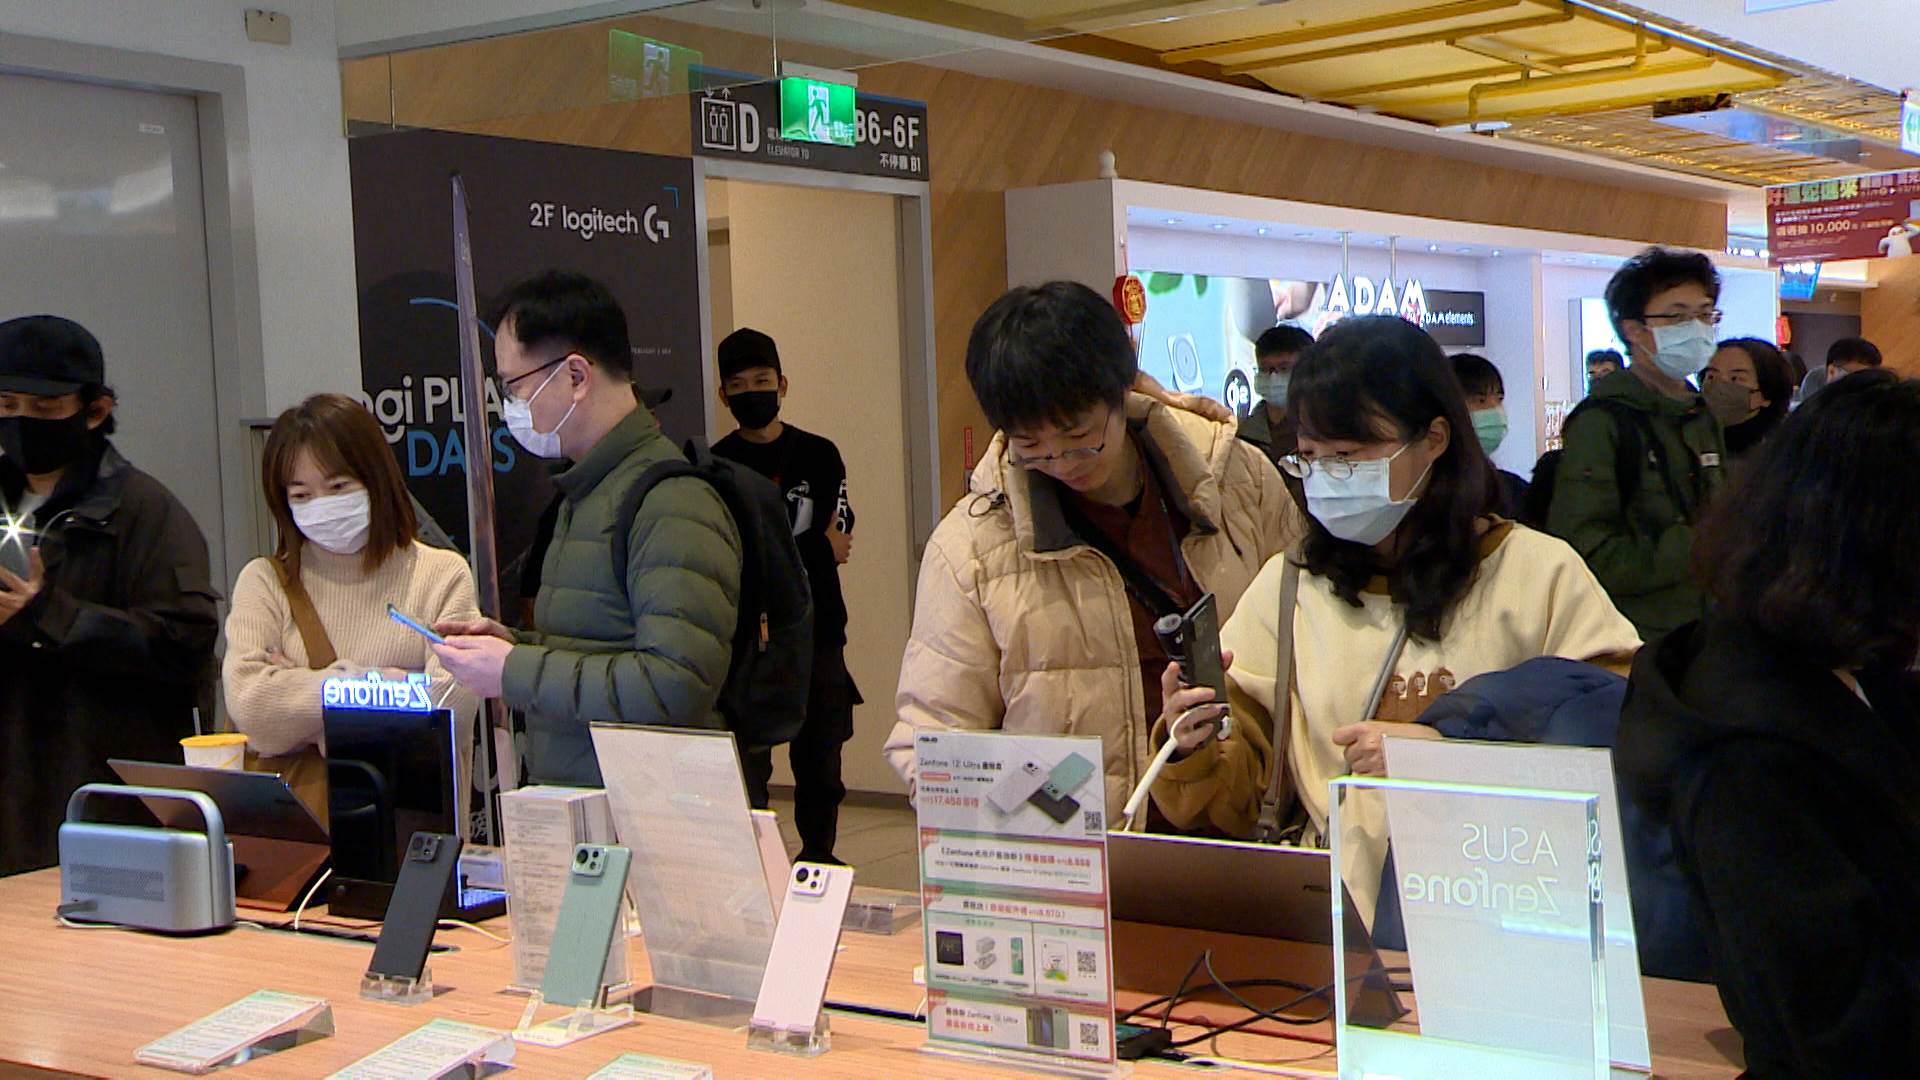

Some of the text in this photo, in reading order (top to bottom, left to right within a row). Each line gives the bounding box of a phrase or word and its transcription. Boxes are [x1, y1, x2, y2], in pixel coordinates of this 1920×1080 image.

[739, 103, 760, 152] D
[911, 157, 920, 172] B1
[533, 203, 554, 227] 2F
[562, 206, 639, 240] logitech
[1810, 220, 1850, 234] 10,000
[1327, 273, 1428, 316] ADAM
[407, 428, 516, 476] DAS
